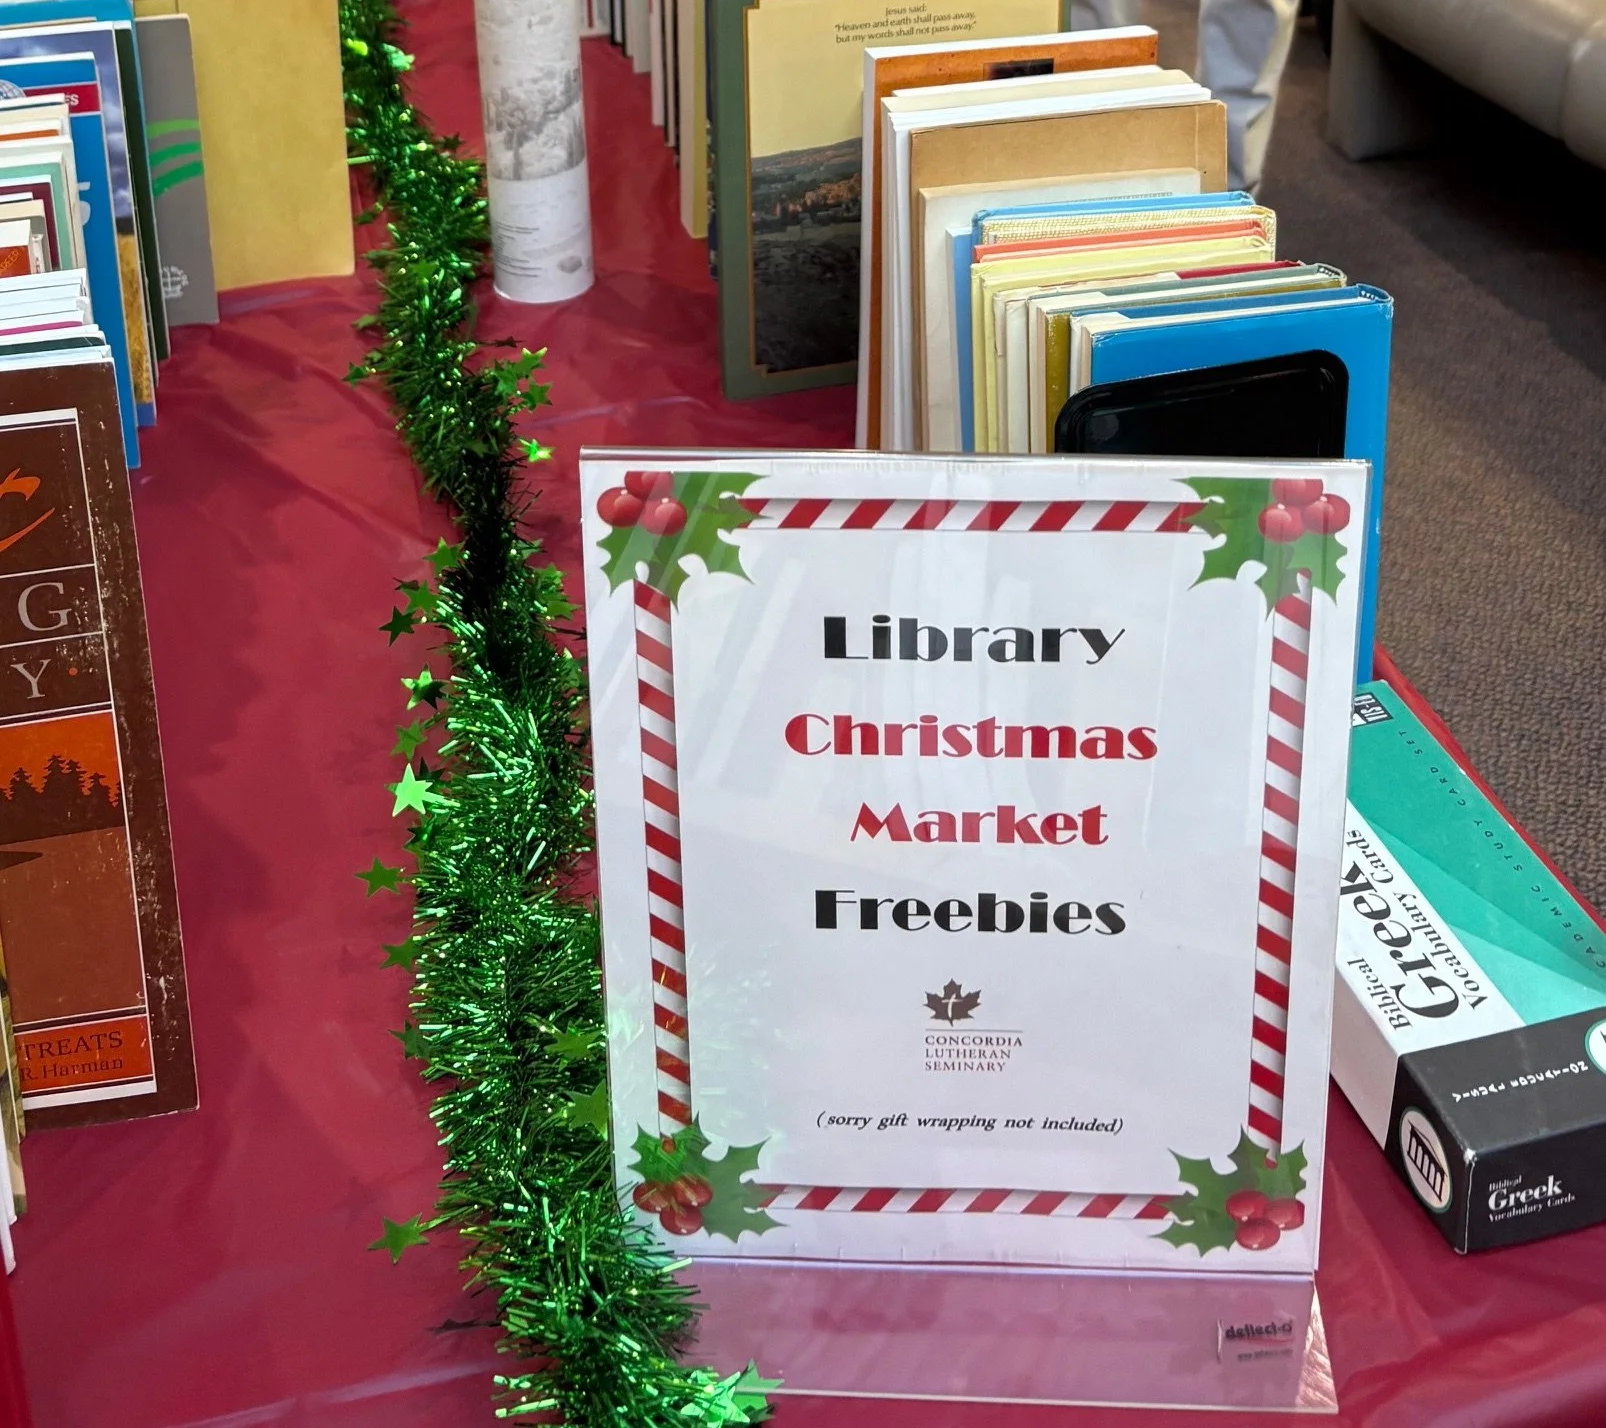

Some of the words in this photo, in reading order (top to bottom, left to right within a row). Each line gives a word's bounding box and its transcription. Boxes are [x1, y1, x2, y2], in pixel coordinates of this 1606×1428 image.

[872, 19, 889, 28] and
[889, 17, 912, 26] earth
[913, 14, 932, 23] shall
[933, 14, 951, 23] pass
[885, 7, 907, 17] Jesus
[908, 3, 927, 14] said:
[836, 34, 851, 43] but
[852, 33, 866, 42] my
[867, 29, 894, 40] words
[895, 27, 914, 37] shall
[915, 26, 930, 34] not
[931, 25, 949, 35] pass
[823, 614, 1126, 664] Library
[784, 713, 1158, 760] Christmas
[1398, 730, 1423, 755] SET
[1430, 766, 1467, 806] CARD
[850, 801, 1109, 846] Market
[1346, 829, 1394, 884] Cards
[1473, 819, 1523, 872] STUDY
[814, 889, 1127, 935] Freebies
[1340, 860, 1459, 1019] Greek
[1393, 892, 1489, 1010] Vocabulary
[1347, 957, 1413, 1030] Biblical
[16, 1030, 123, 1061] TREATS
[925, 1035, 1023, 1048] CONCORDIA
[925, 1048, 1011, 1060] LUTHERAN
[41, 1059, 123, 1079] Harman
[925, 1060, 1007, 1073] SEMINARY
[1451, 1082, 1506, 1103] VISUAL
[1510, 1060, 1589, 1088] EDUCATION
[816, 1110, 872, 1130] (sorry
[877, 1113, 910, 1131] gift
[916, 1115, 997, 1133] wrapping
[1003, 1116, 1035, 1130] not
[1042, 1117, 1124, 1136] included)
[1488, 1174, 1562, 1211] Greek
[1488, 1204, 1543, 1222] Vocabulary
[1547, 1192, 1576, 1207] Cards
